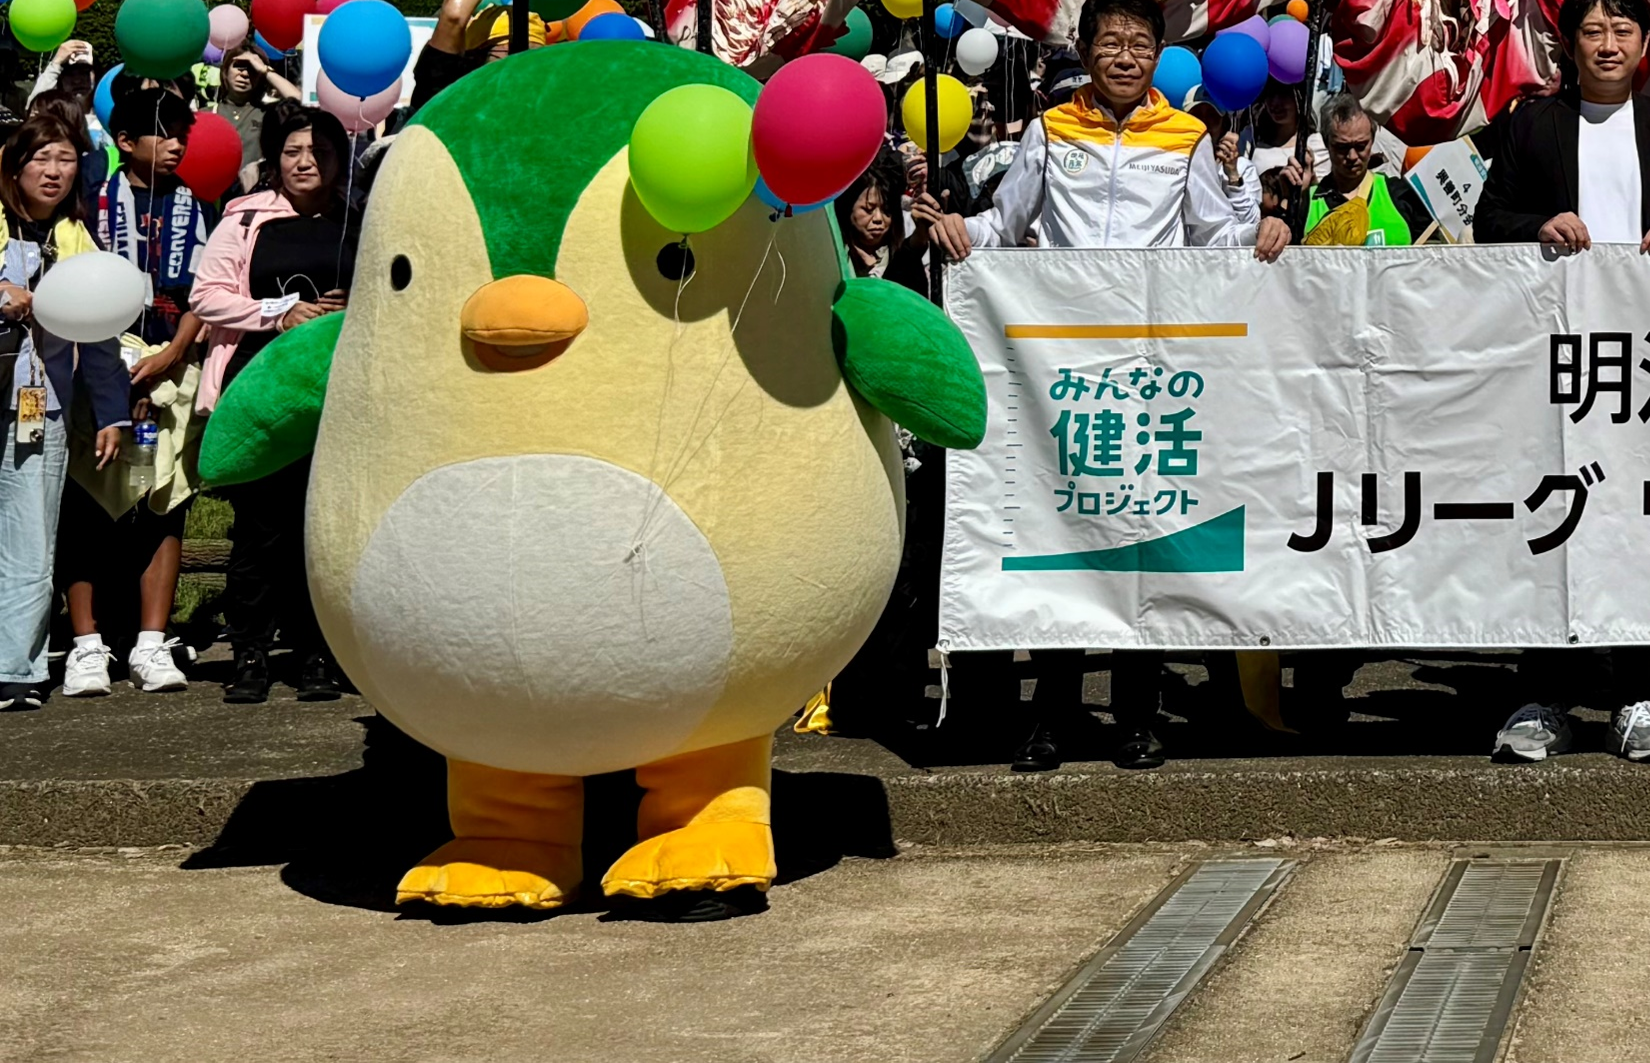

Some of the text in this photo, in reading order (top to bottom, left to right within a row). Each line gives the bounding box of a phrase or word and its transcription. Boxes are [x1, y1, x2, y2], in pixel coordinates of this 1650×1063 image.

[1129, 163, 1180, 176] MEIJI YASUDA
[1462, 183, 1472, 193] 4
[167, 185, 193, 279] CONVERSE
[1049, 367, 1205, 402] みんなの
[1050, 408, 1203, 478] 健活
[1054, 482, 1200, 516] プロジェクト
[1286, 461, 1607, 556] Jリーグ
